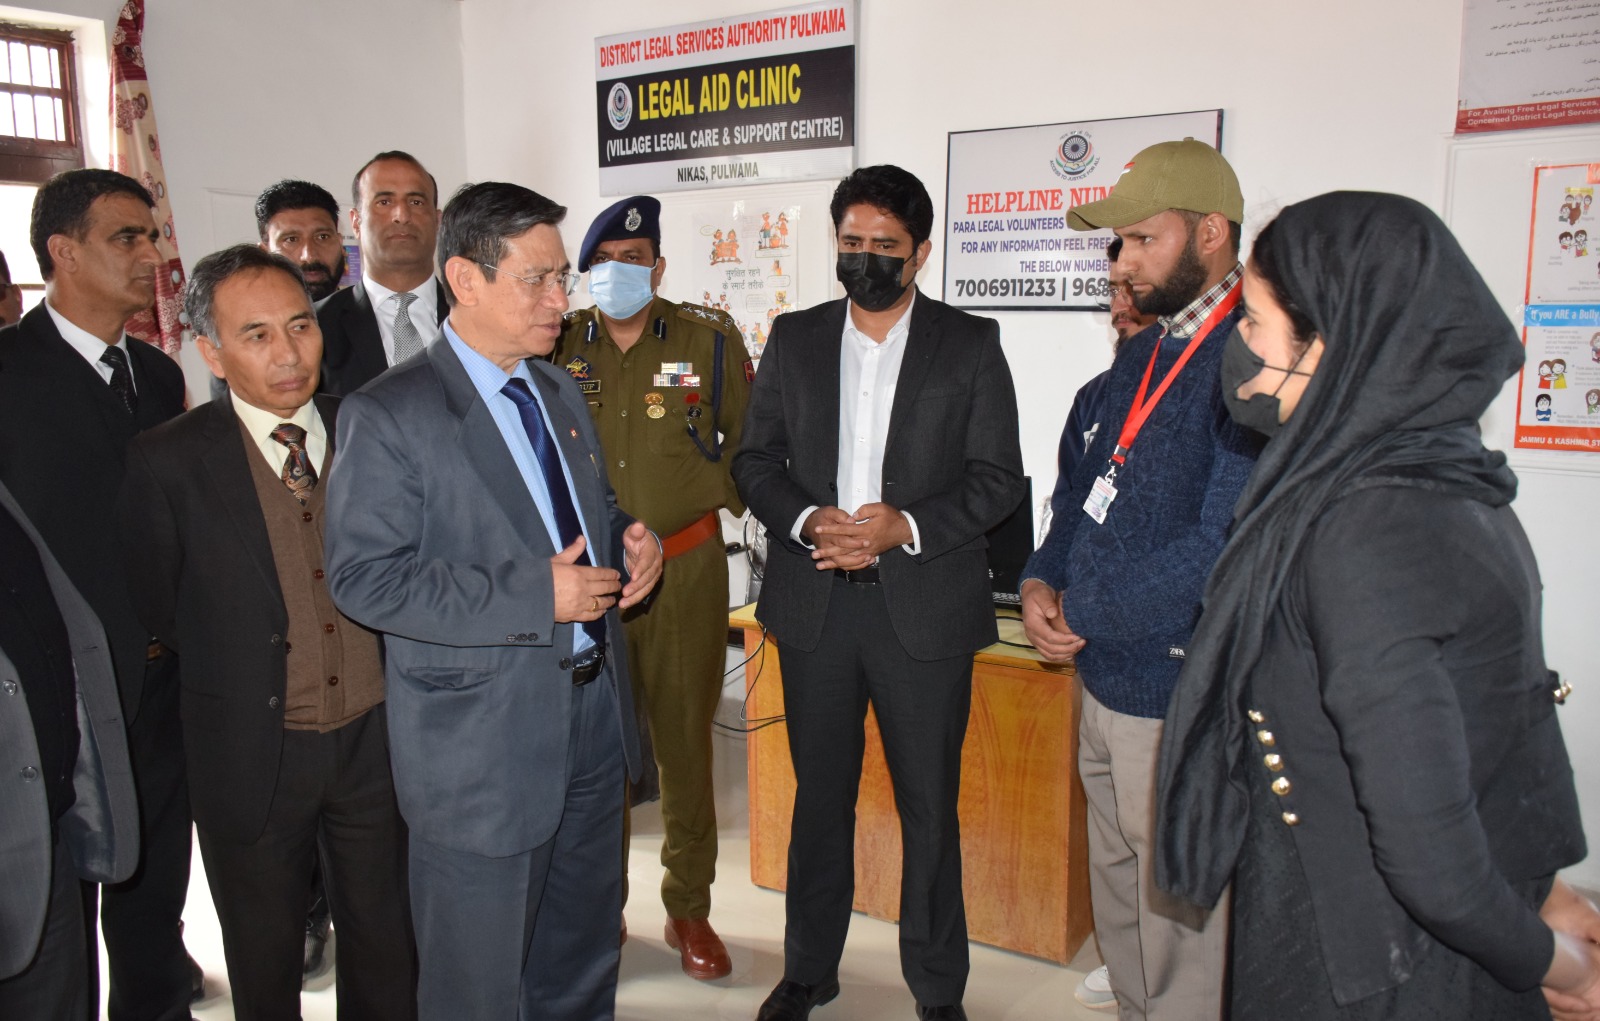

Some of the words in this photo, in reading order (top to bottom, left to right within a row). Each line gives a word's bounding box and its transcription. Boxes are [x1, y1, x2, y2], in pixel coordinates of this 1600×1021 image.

[600, 40, 641, 67] DISTRICT
[644, 36, 673, 60] LEGAL
[676, 26, 724, 54] SERVICES
[726, 16, 787, 47] AUTHORITY
[790, 7, 846, 39] PULWAMA
[638, 78, 694, 121] LEGAL
[699, 73, 730, 113] AID
[736, 63, 801, 109] CLINIC
[1468, 117, 1510, 126] Concerned
[1512, 114, 1541, 122] District
[1543, 111, 1565, 120] Legal
[1482, 108, 1514, 117] Availing
[1517, 105, 1535, 113] Free
[1537, 103, 1559, 112] Legal
[606, 135, 651, 162] (VILLAGE
[654, 131, 687, 151] LEGAL
[690, 129, 719, 148] CARE
[722, 128, 730, 145] &
[734, 121, 788, 144] SUPPORT
[791, 116, 844, 141] CENTRE)
[677, 165, 709, 184] NIKAS,
[710, 161, 759, 180] PULWAMA
[966, 188, 1064, 215] HELPLINE
[1069, 186, 1116, 210] NUM
[953, 221, 976, 234] PARA
[978, 219, 1004, 233] LEGAL
[1007, 216, 1064, 231] VOLUNTEERS
[962, 241, 978, 254] FOR
[979, 240, 998, 253] ANY
[1000, 238, 1062, 252] INFORMATION
[1064, 238, 1086, 250] FEEL
[1087, 236, 1111, 250] FREE
[1020, 260, 1037, 273] THE
[1038, 260, 1071, 273] BELOW
[955, 277, 1056, 297] 7006911233
[1538, 311, 1552, 321] you
[1554, 309, 1569, 320] ARE
[1571, 311, 1577, 320] a
[1519, 436, 1545, 444] JAMMU
[1555, 437, 1590, 446] KASHMIR
[1592, 439, 1600, 447] ST
[1169, 647, 1185, 656] ZARA
